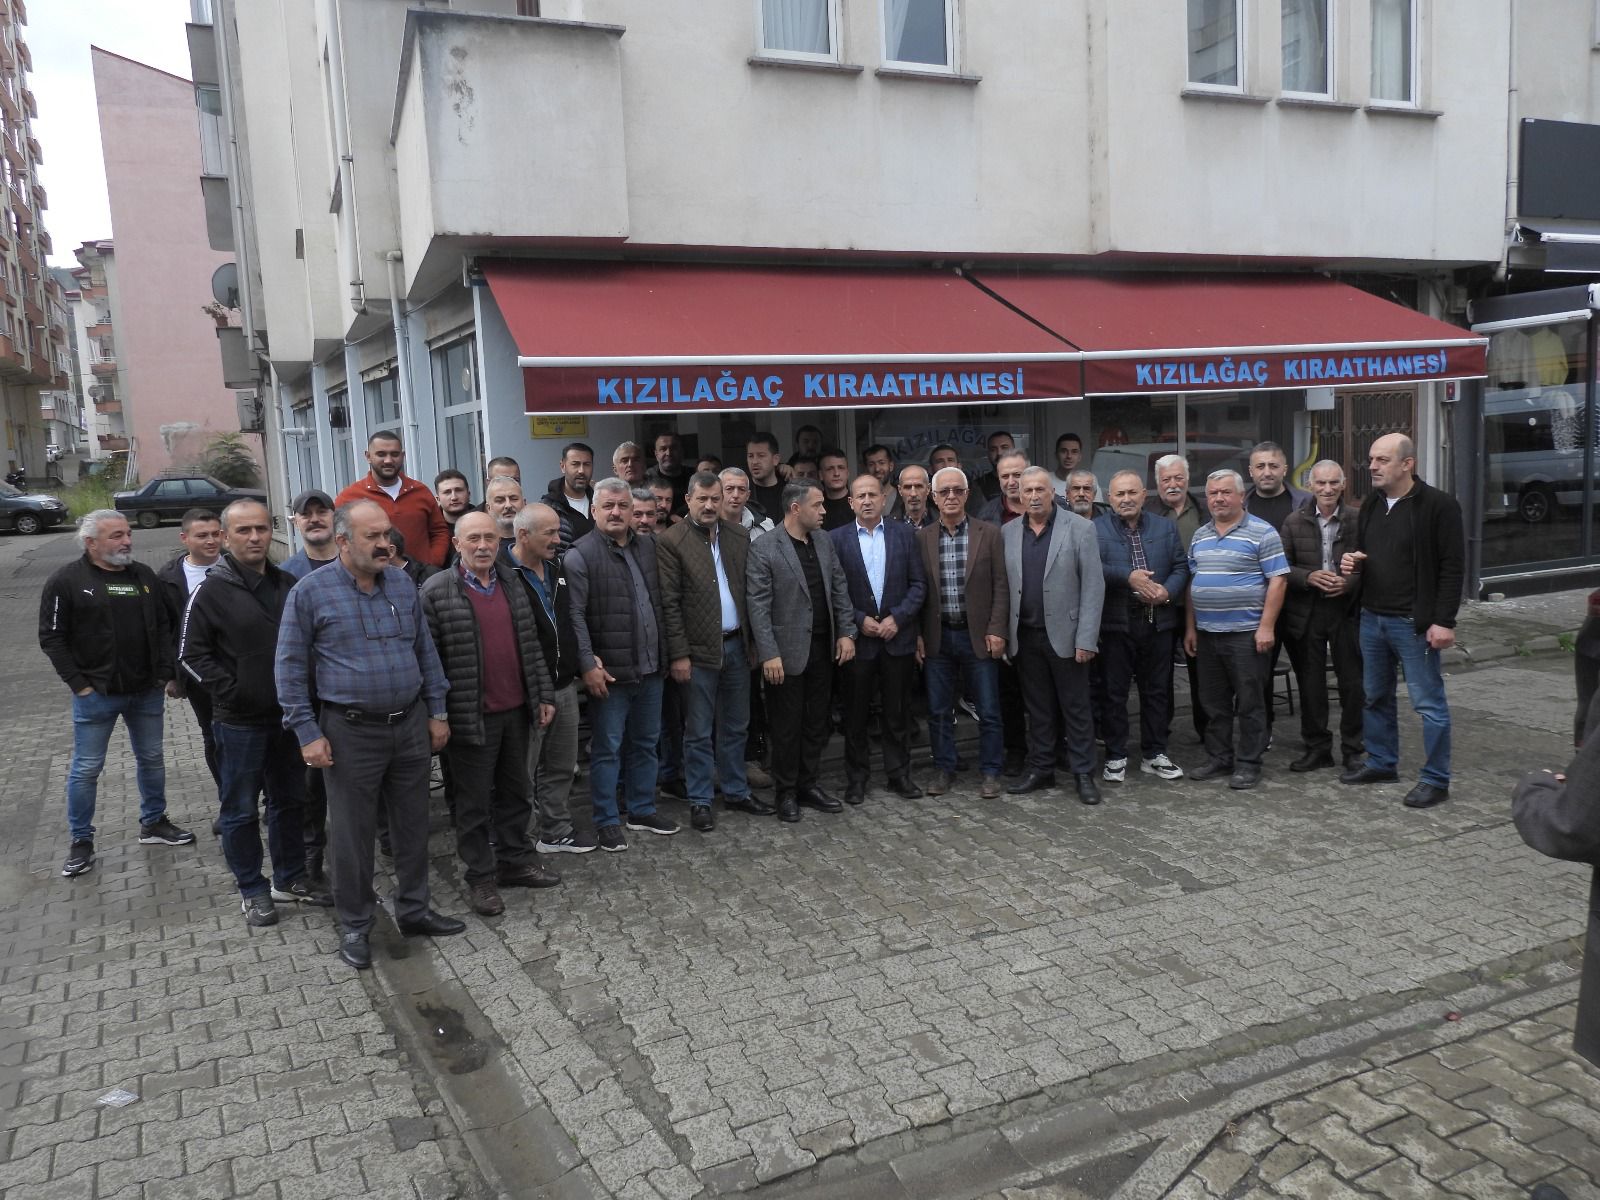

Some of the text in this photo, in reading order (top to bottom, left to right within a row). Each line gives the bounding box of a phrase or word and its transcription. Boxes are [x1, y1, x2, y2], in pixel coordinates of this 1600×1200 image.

[598, 367, 1024, 407] KIZILAĞAÇ KIRAATHANESİ
[1136, 350, 1447, 386] KIZILAĞAÇ KIRAATHANESİ
